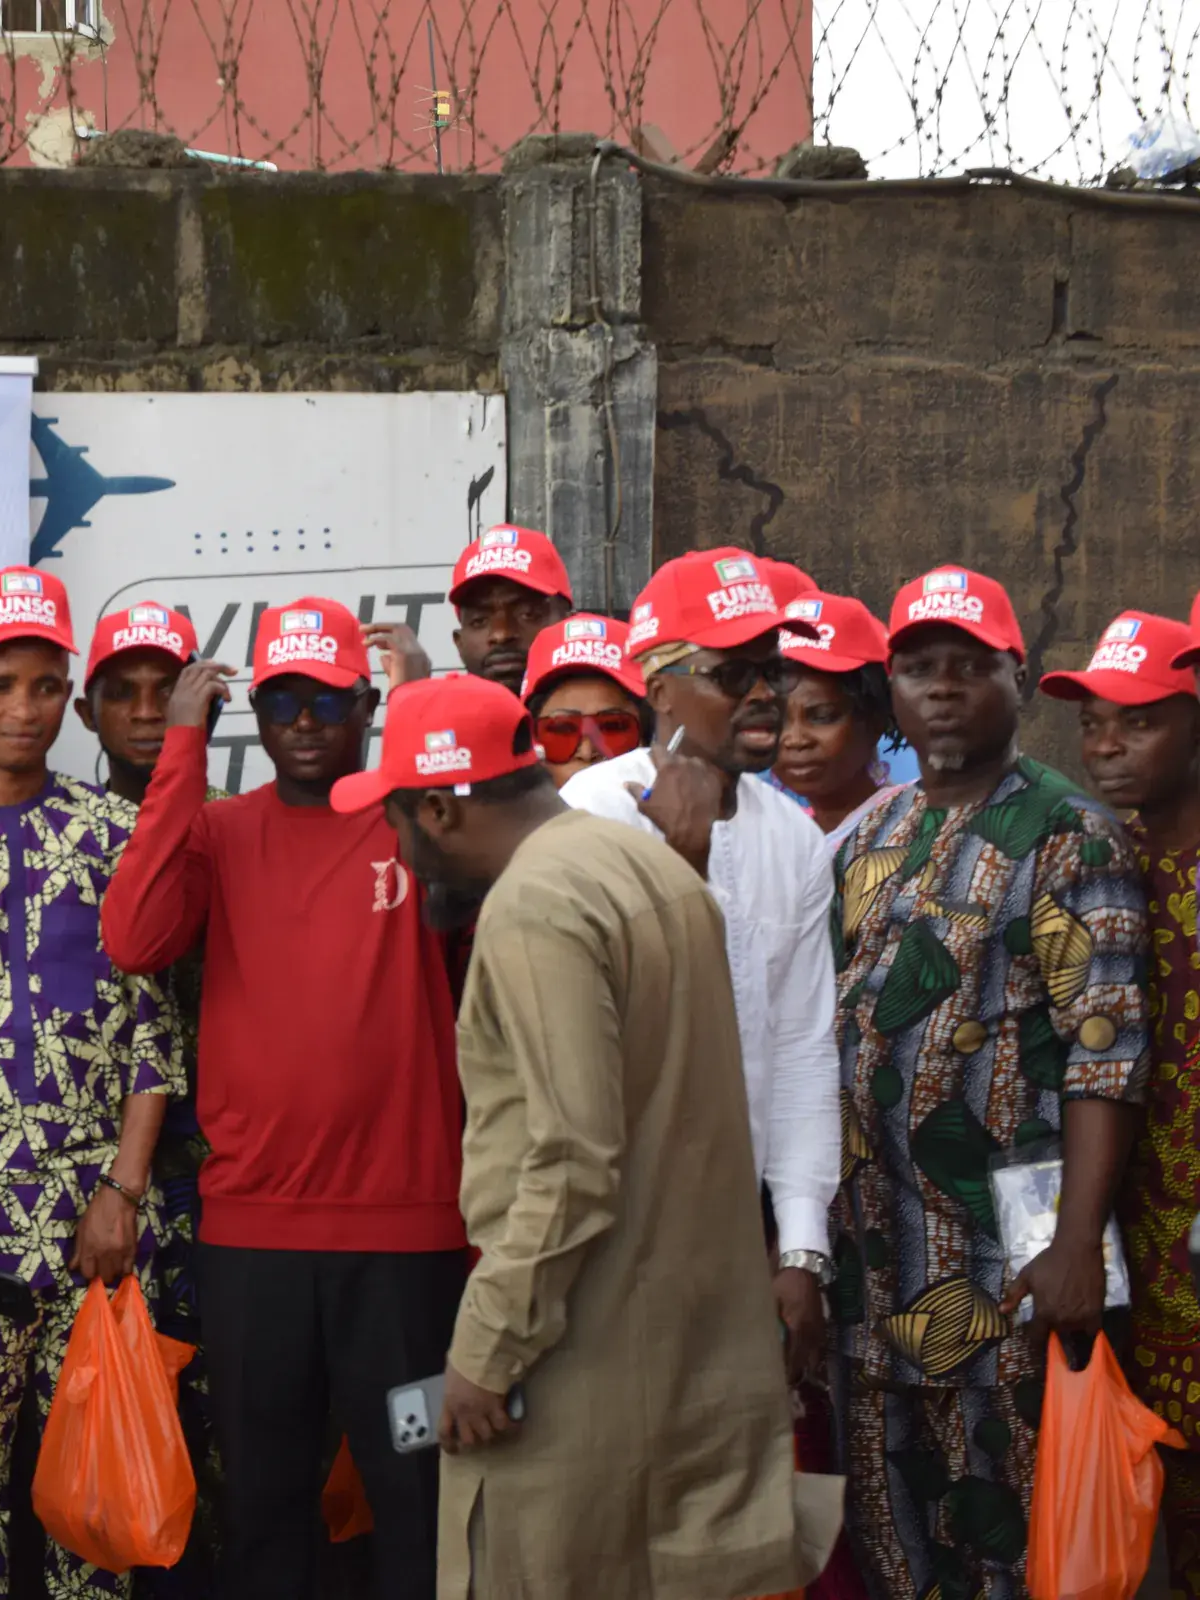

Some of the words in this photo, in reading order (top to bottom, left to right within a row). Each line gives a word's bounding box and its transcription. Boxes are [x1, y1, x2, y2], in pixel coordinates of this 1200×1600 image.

[466, 547, 532, 577] FUNSO
[908, 592, 984, 620] FUNSO
[113, 626, 184, 651] FUNSO
[268, 634, 338, 660] FUNSO
[552, 640, 622, 666] FUNSO
[415, 747, 472, 771] FUNSO
